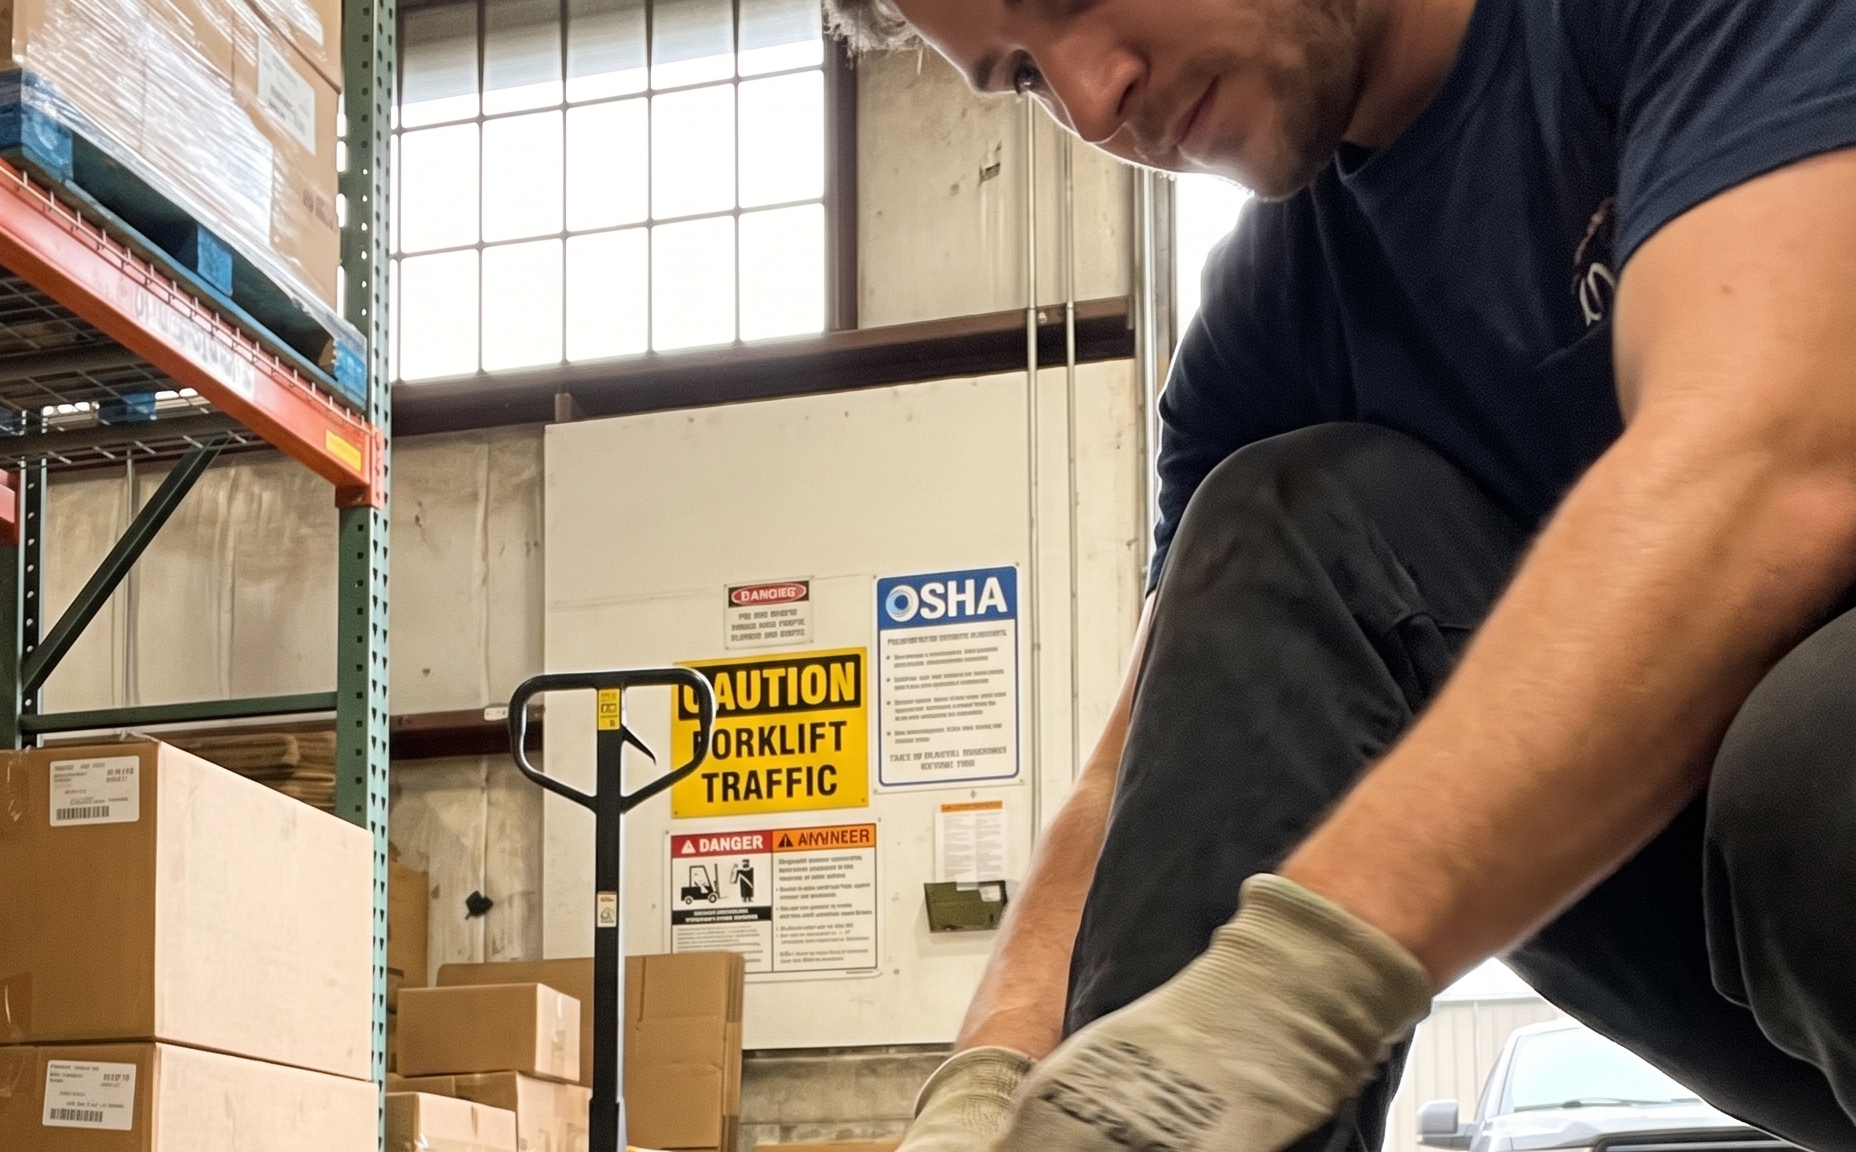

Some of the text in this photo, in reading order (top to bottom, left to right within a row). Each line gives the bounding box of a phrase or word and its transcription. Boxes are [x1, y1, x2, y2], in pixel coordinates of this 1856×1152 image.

[885, 577, 1008, 622] OSHA
[701, 764, 838, 803] TRAFFIC
[700, 834, 764, 852] DANGER
